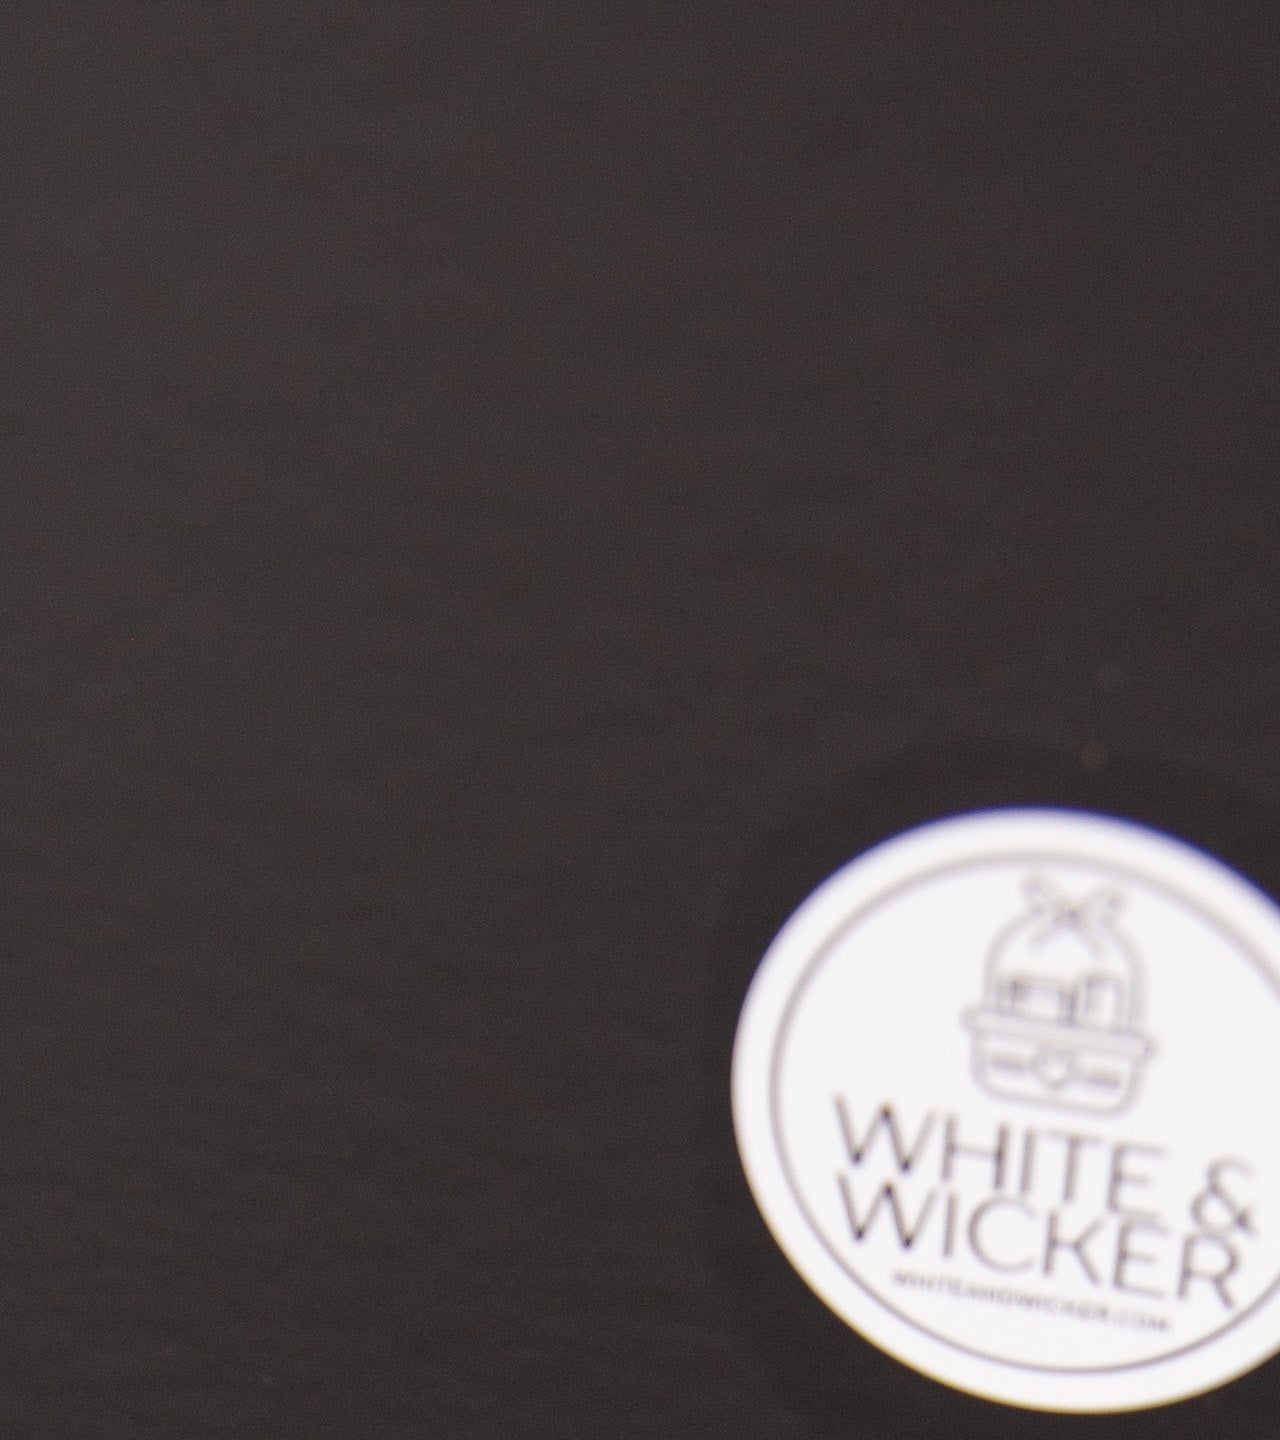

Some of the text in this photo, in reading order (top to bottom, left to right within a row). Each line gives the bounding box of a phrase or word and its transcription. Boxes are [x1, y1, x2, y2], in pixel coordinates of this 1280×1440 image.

[831, 1092, 1259, 1239] WHITE &
[836, 1170, 1242, 1309] WICKER
